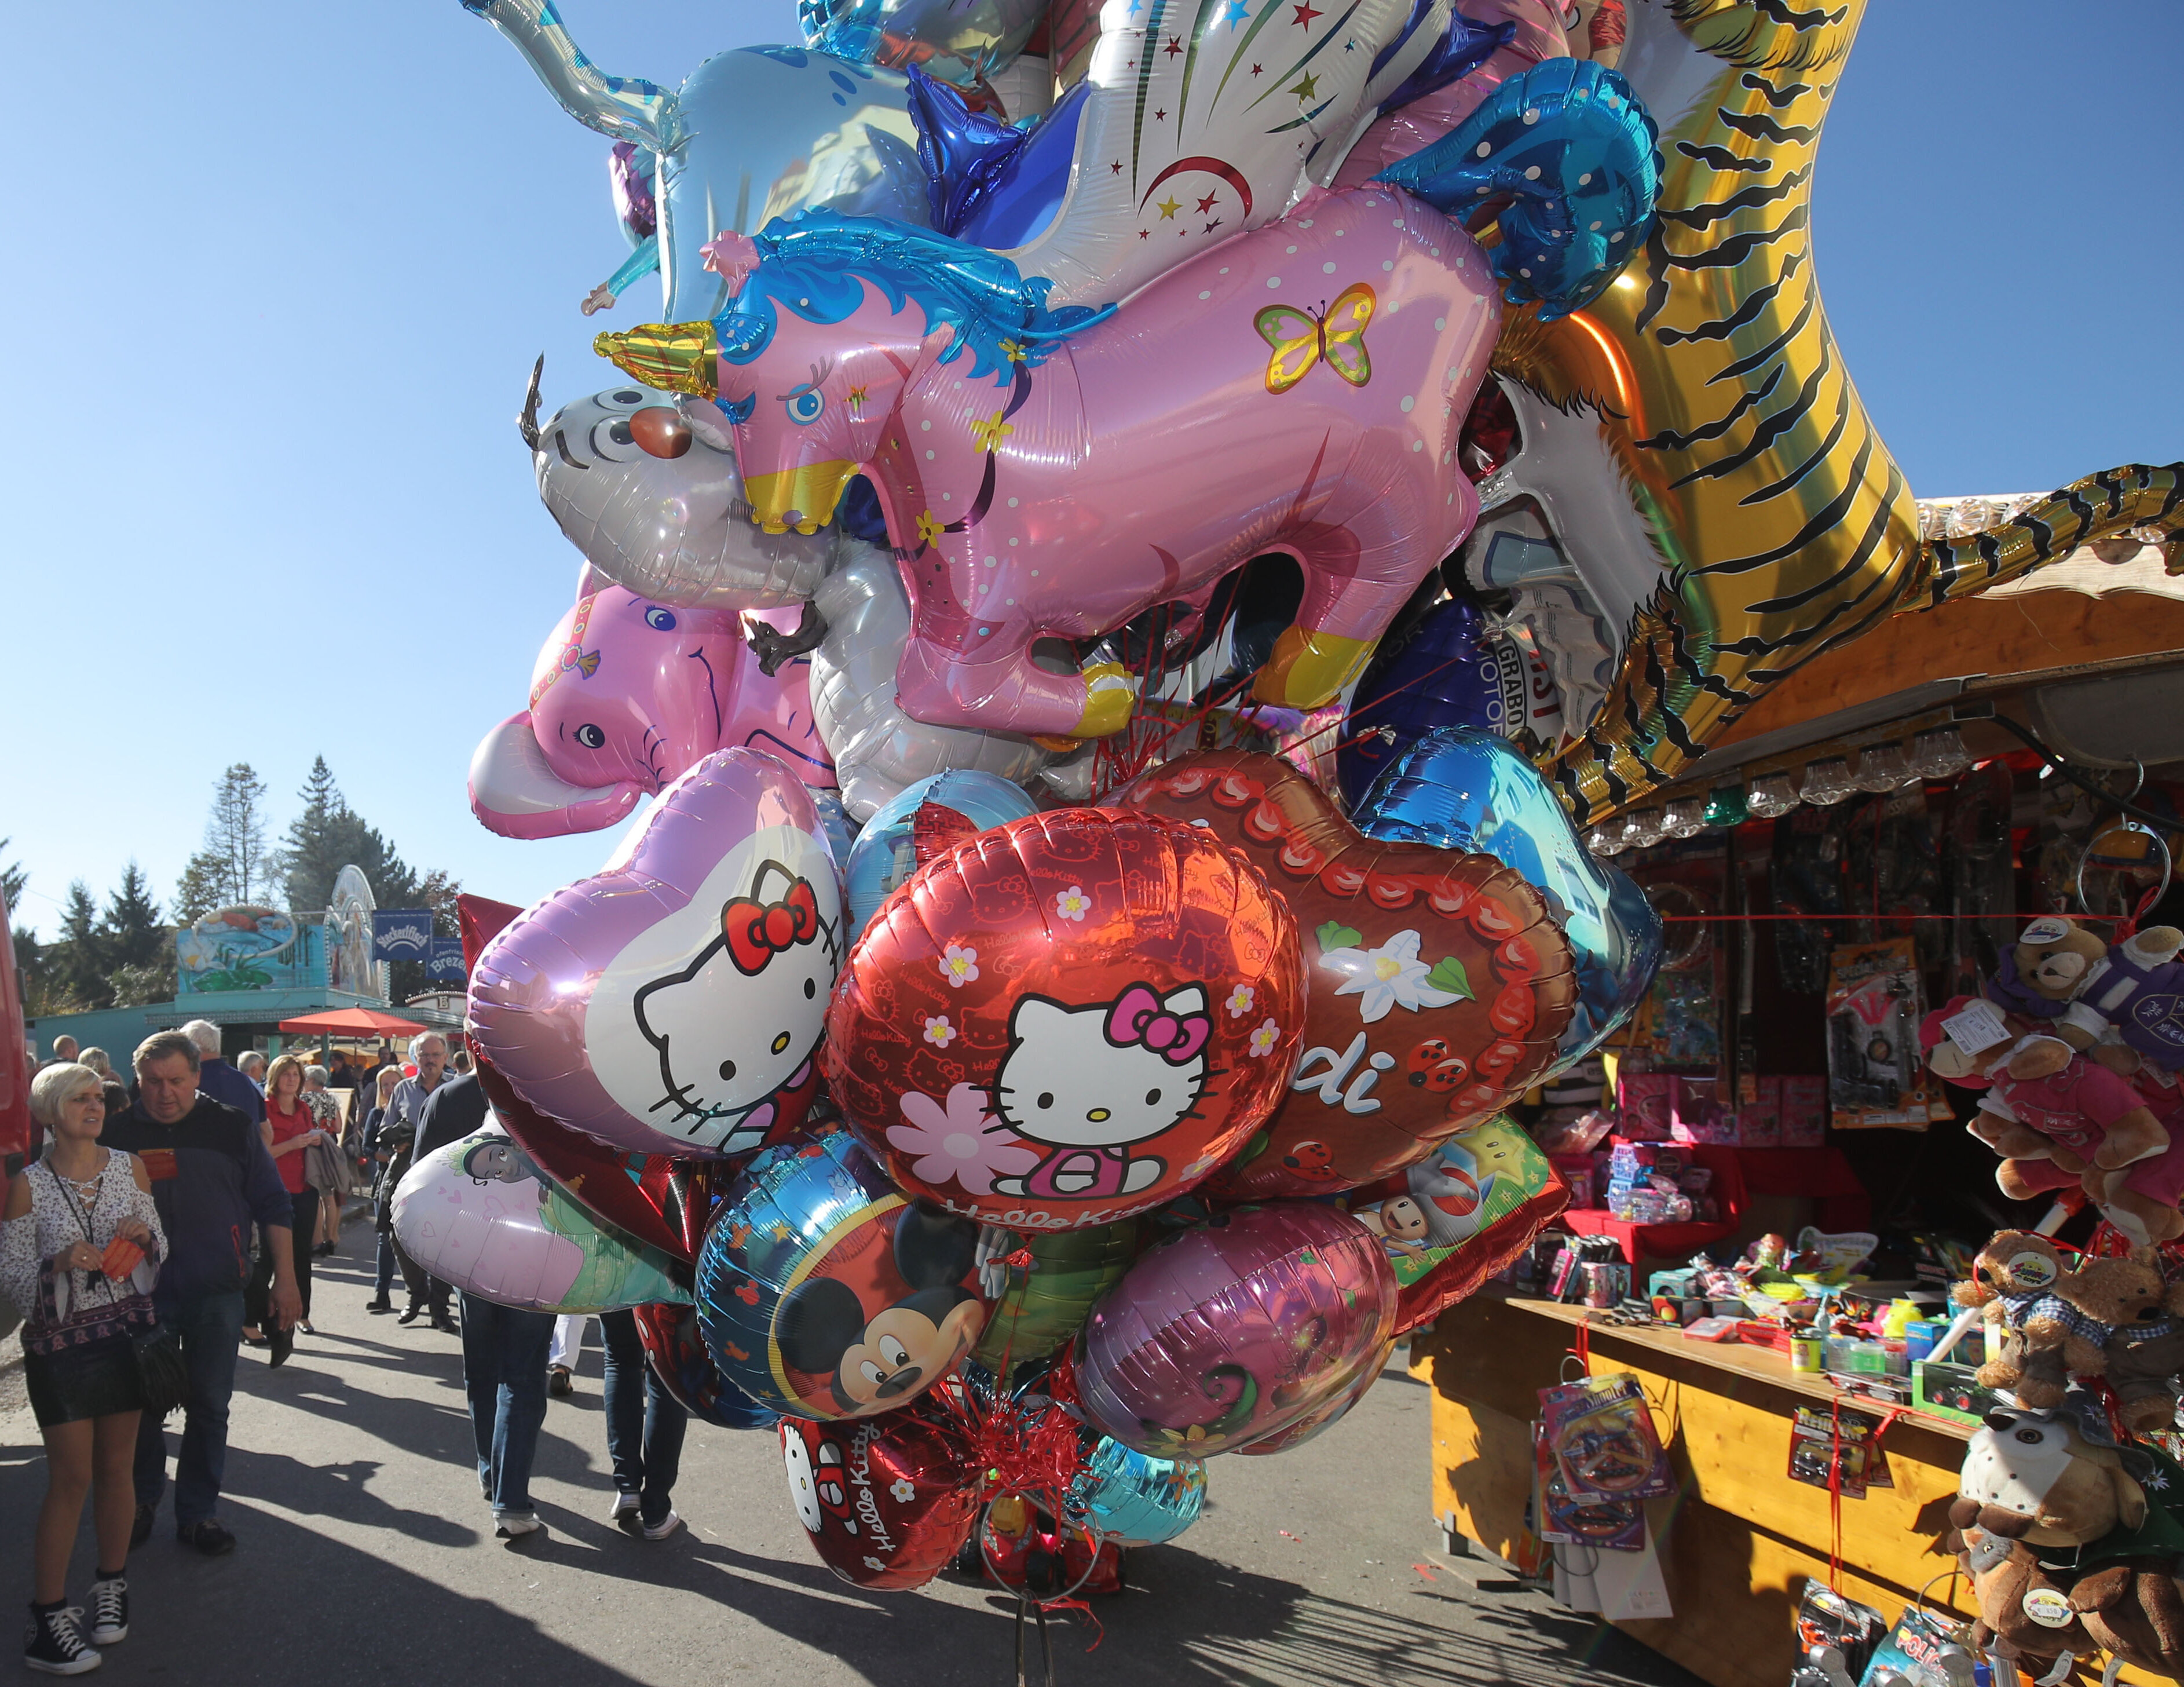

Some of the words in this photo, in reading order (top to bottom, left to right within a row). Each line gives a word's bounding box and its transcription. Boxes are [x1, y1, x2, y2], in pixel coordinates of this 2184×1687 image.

[1498, 645, 1525, 726] GRABO
[376, 924, 429, 948] Steckerlfisch
[984, 931, 1018, 950] Hello
[899, 970, 927, 992] Hello
[925, 985, 951, 1010] Kitty
[861, 1027, 887, 1041] Hello
[886, 1032, 913, 1048] Kitty
[939, 1199, 1072, 1228] Hello
[849, 1423, 881, 1486] Kitty
[855, 1487, 897, 1552] Hello
